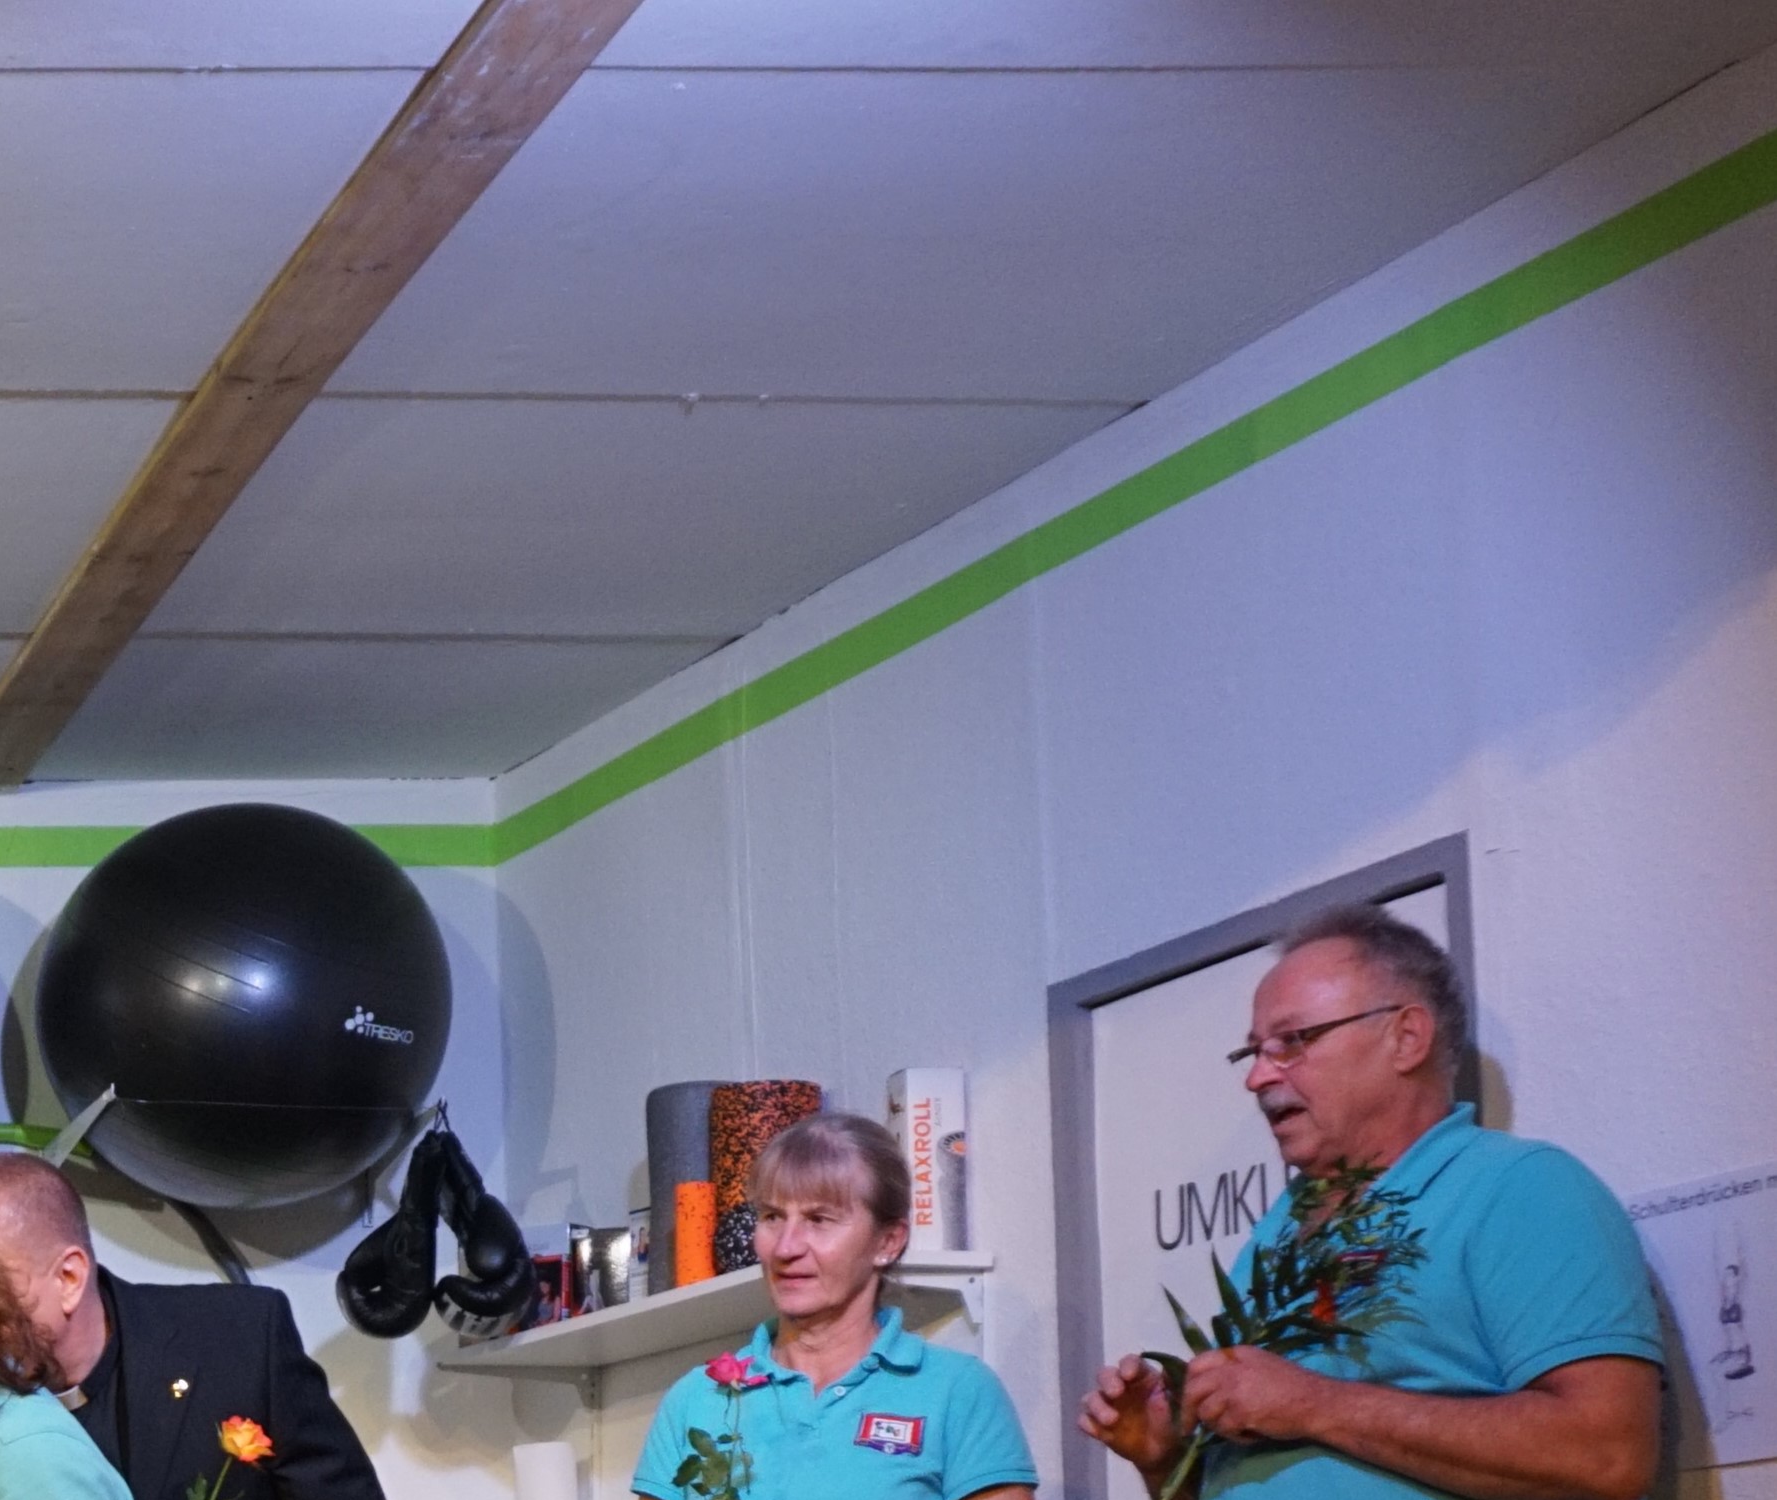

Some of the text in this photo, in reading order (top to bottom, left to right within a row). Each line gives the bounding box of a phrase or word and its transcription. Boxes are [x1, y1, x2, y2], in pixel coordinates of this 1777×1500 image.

[364, 1021, 414, 1044] TRESKO
[912, 1097, 934, 1227] RELAXROLL
[1628, 1179, 1763, 1223] Schulterdrücken
